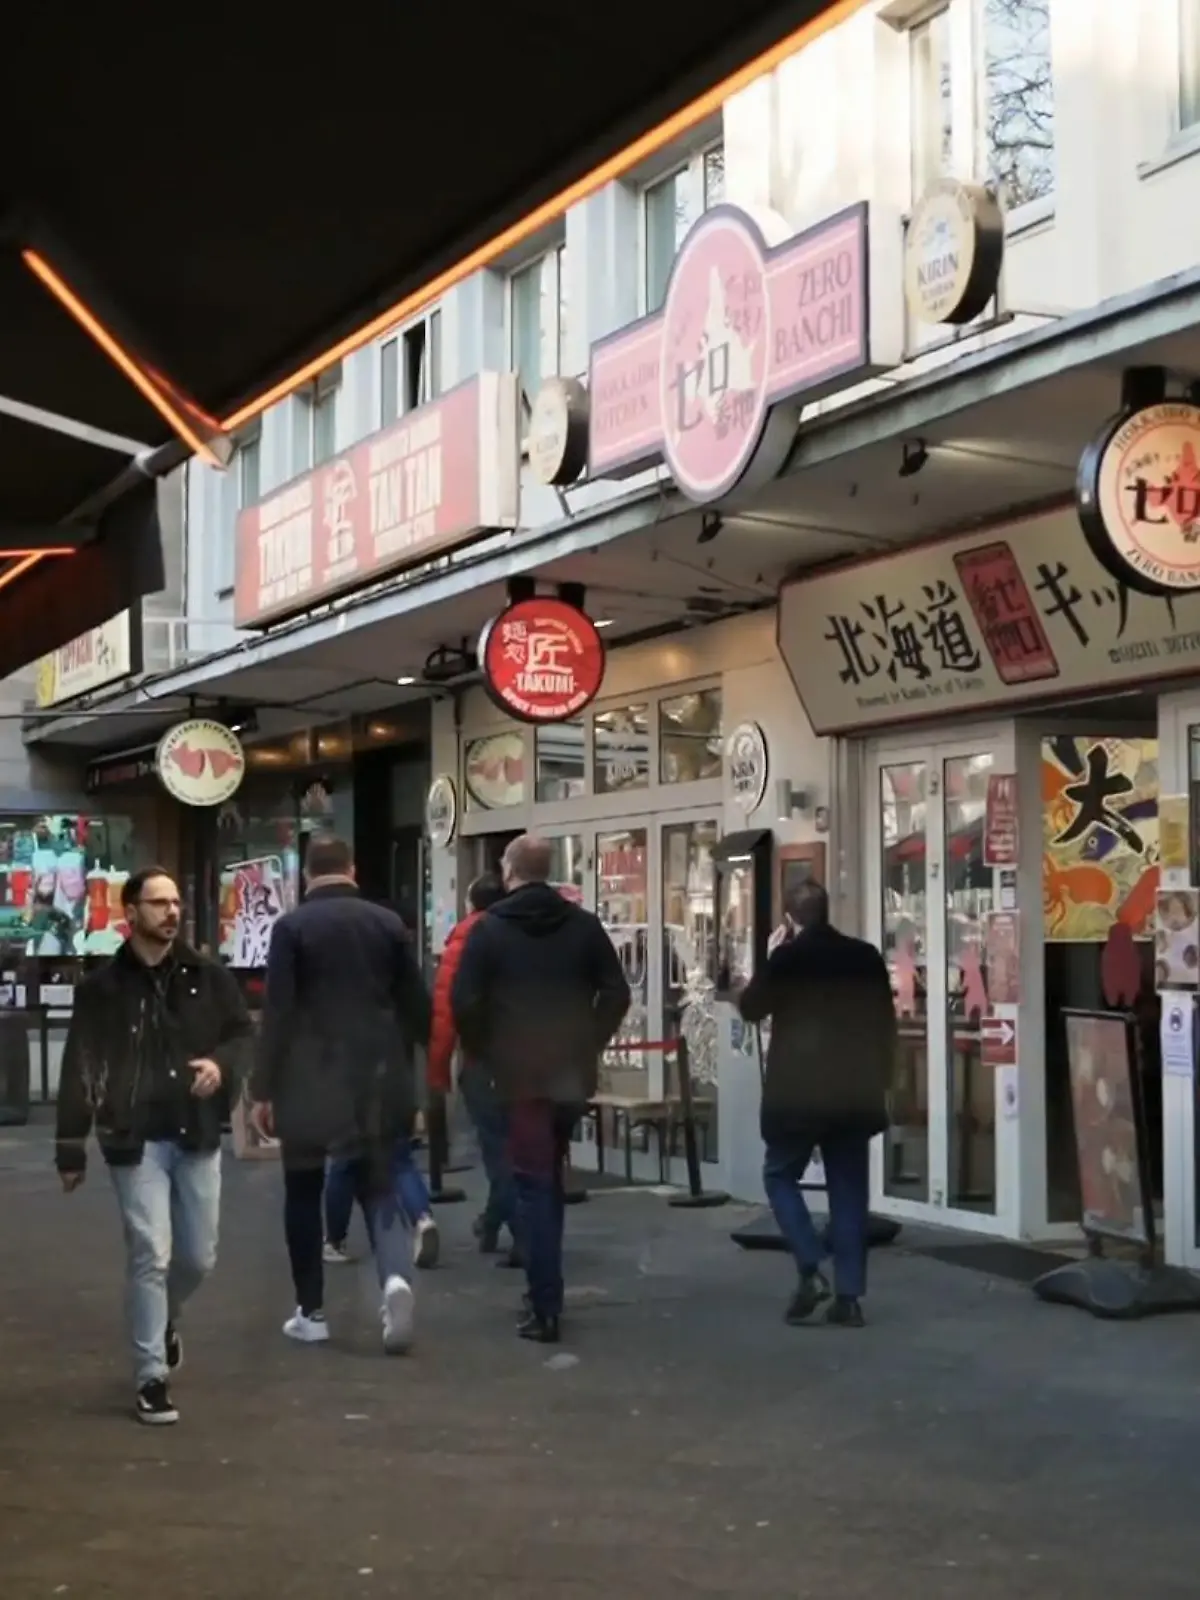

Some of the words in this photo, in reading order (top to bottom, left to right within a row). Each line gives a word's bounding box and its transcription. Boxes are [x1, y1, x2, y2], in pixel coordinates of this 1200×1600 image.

[798, 251, 852, 310] ZERO
[918, 252, 958, 287] KIRIN
[775, 292, 852, 365] BANCHI
[1114, 404, 1191, 451] HOKKAIDO
[1127, 549, 1164, 582] ZERO
[525, 632, 572, 675] 匠
[824, 580, 982, 686] 北海道
[515, 672, 574, 693] TAKUMI
